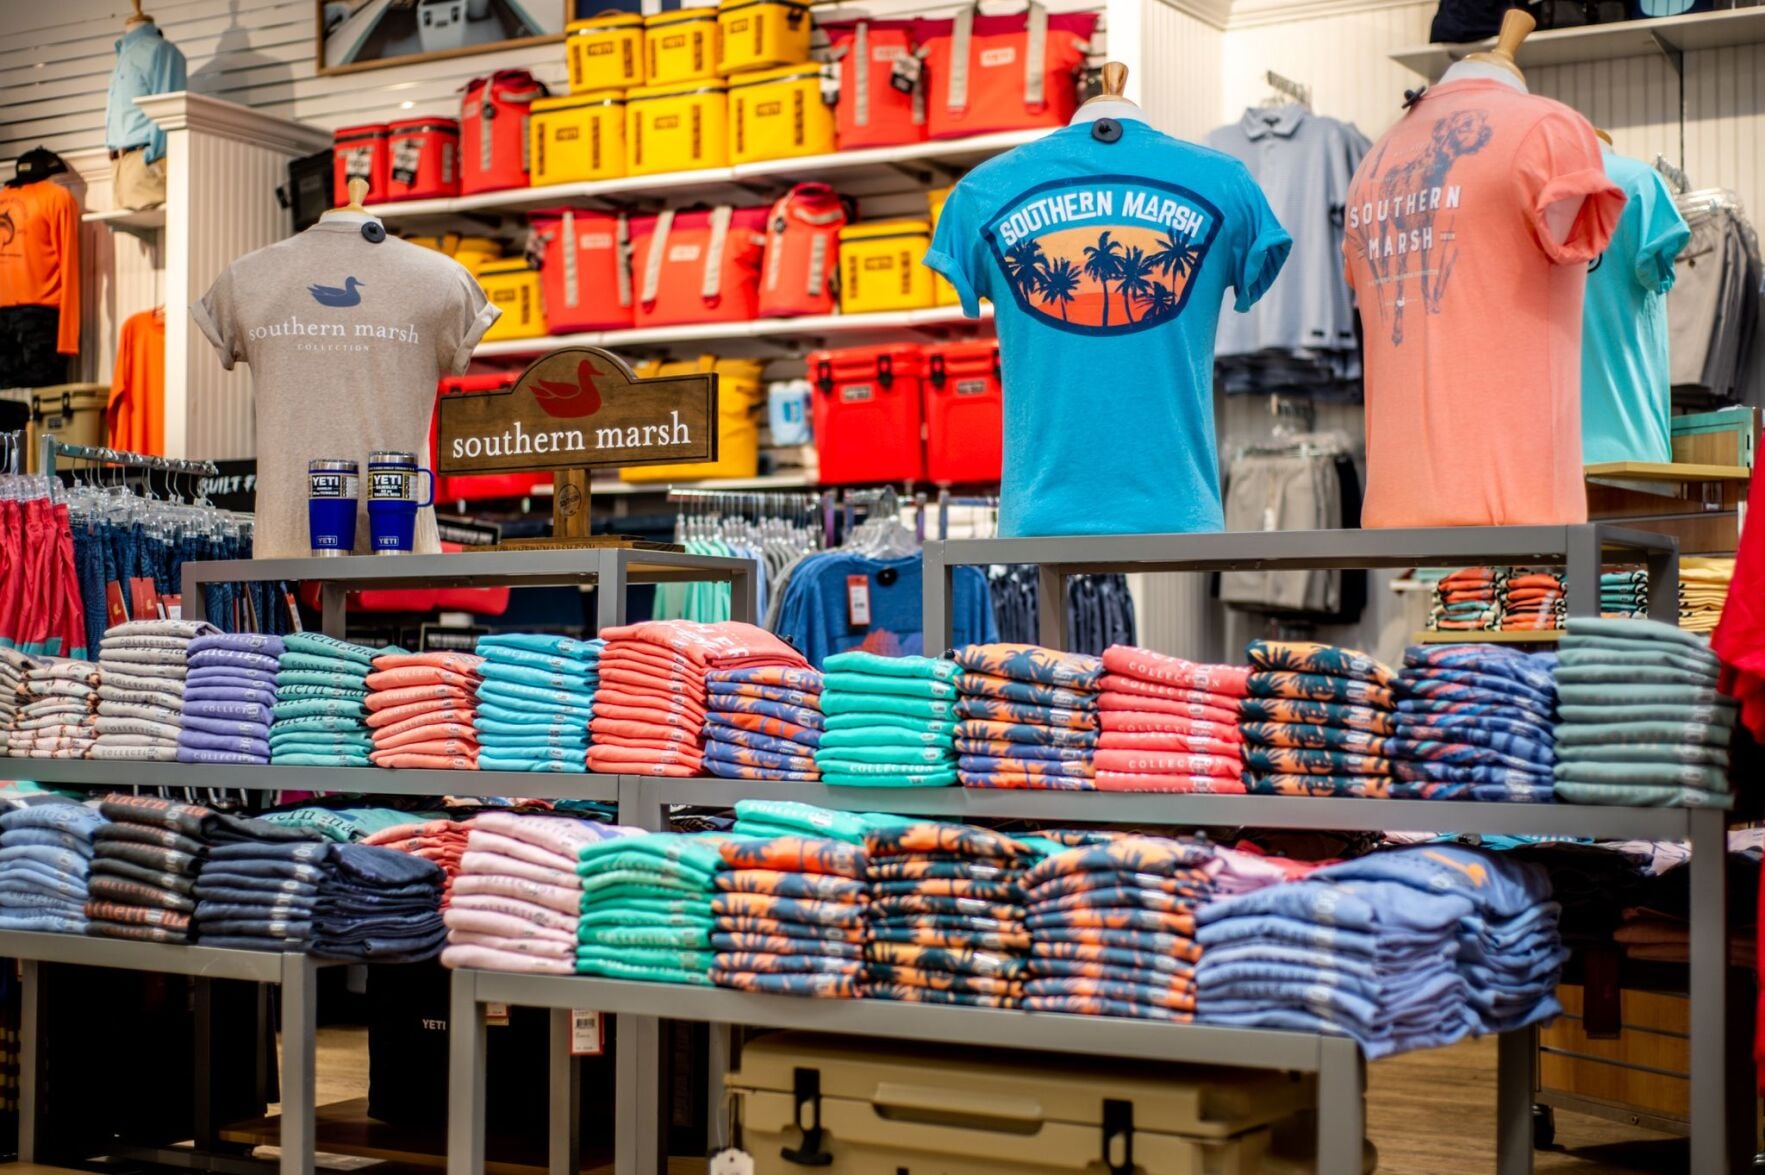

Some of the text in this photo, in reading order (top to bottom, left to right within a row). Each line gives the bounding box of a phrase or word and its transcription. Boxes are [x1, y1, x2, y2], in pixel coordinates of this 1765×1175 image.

[1350, 185, 1461, 229] SOUTHERN
[1000, 190, 1205, 247] SOUTHERN MARSH
[1368, 226, 1433, 260] MARSH
[250, 315, 420, 344] southern marsh
[297, 343, 370, 352] COLLECTION
[452, 410, 691, 459] southern marsh
[312, 476, 339, 486] YETI
[373, 474, 402, 485] YETI
[379, 537, 398, 545] YETI
[422, 1018, 446, 1031] YETI
